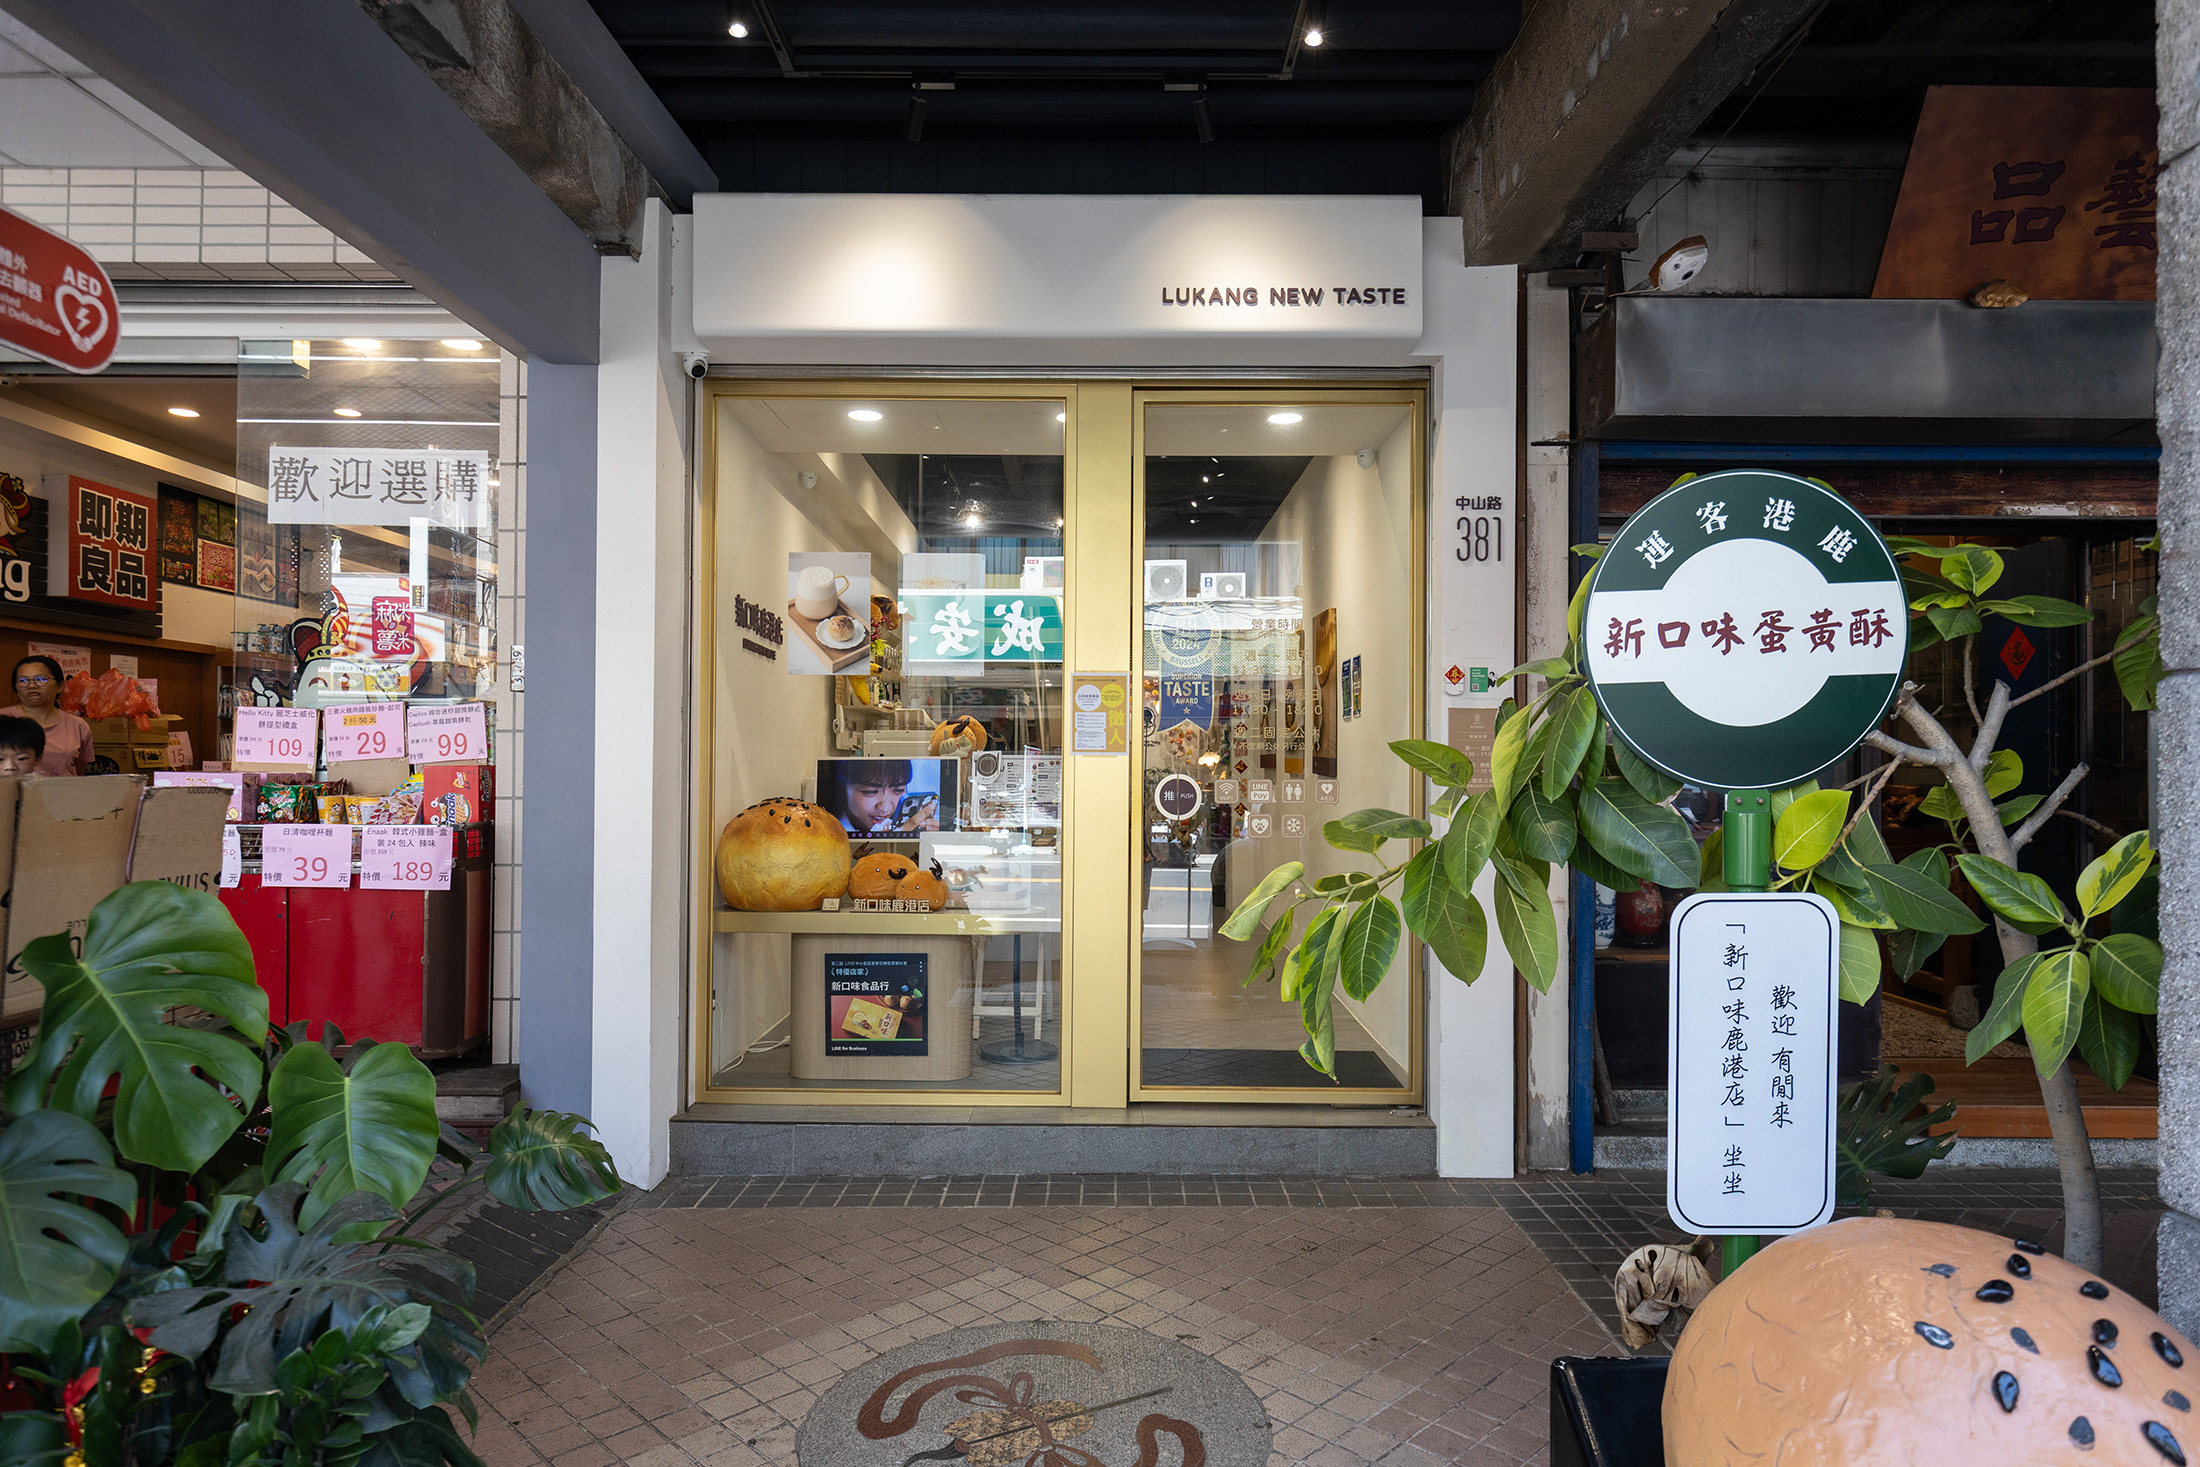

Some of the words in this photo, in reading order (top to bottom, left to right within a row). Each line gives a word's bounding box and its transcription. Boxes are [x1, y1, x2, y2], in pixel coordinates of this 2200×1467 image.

[63, 264, 102, 298] AED
[1162, 287, 1259, 305] LUKANG
[1270, 287, 1324, 305] NEW
[1332, 287, 1406, 305] TASTE
[271, 456, 478, 505] 歡迎選購
[1456, 495, 1502, 510] 中山路
[77, 487, 149, 551] 即期
[1457, 516, 1502, 562] 381
[77, 543, 149, 601] 良品
[1252, 618, 1304, 630] 營業時間
[1603, 608, 1895, 659] 新口味蛋黃酥
[1172, 639, 1201, 650] 2024
[1164, 681, 1210, 697] TASTE
[239, 709, 256, 717] Hello
[267, 738, 302, 757] 109
[357, 731, 387, 755] 29
[437, 732, 468, 757] 99
[171, 749, 185, 764] 15
[409, 752, 424, 760] 特價
[1164, 790, 1175, 801] 推
[1253, 792, 1268, 801] Pay
[367, 828, 388, 836] Enaak
[377, 839, 385, 847] 裝
[387, 839, 396, 847] 24
[419, 839, 436, 848] 辣味
[264, 872, 282, 882] 特價
[292, 856, 328, 882] 39
[338, 872, 348, 883] 元
[362, 872, 381, 882] 特價
[392, 861, 433, 881] 189
[438, 872, 449, 882] 元
[229, 873, 238, 883] 元
[853, 898, 930, 912] 新口味鹿港店
[831, 981, 890, 991] 新口味食品行
